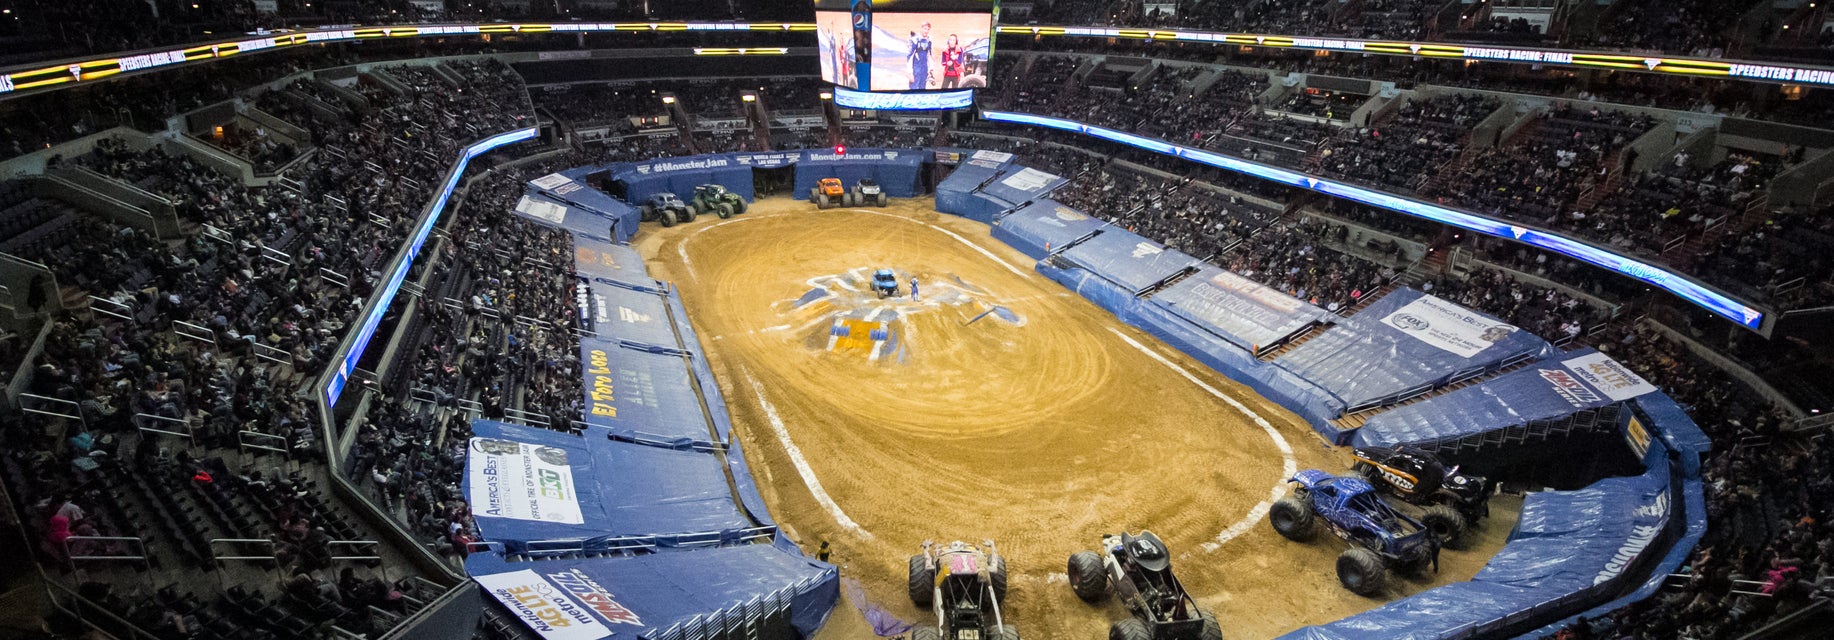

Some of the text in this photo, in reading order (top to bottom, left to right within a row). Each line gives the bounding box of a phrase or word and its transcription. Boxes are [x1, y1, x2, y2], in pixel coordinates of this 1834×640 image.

[1463, 47, 1573, 64] SPEEDSTERS RACING: FINALS
[1728, 64, 1794, 80] SPEEDSTERS
[654, 159, 727, 172] #MonsterJam
[588, 350, 611, 374] Loco
[590, 376, 615, 401] Toro
[1538, 369, 1602, 403] AMSOIL
[591, 403, 617, 417] El
[484, 456, 501, 515] AMERICA'S BEST
[496, 588, 553, 632] Nationwide
[507, 585, 572, 627] 4G LTE
[546, 572, 645, 627] AMSOIL
